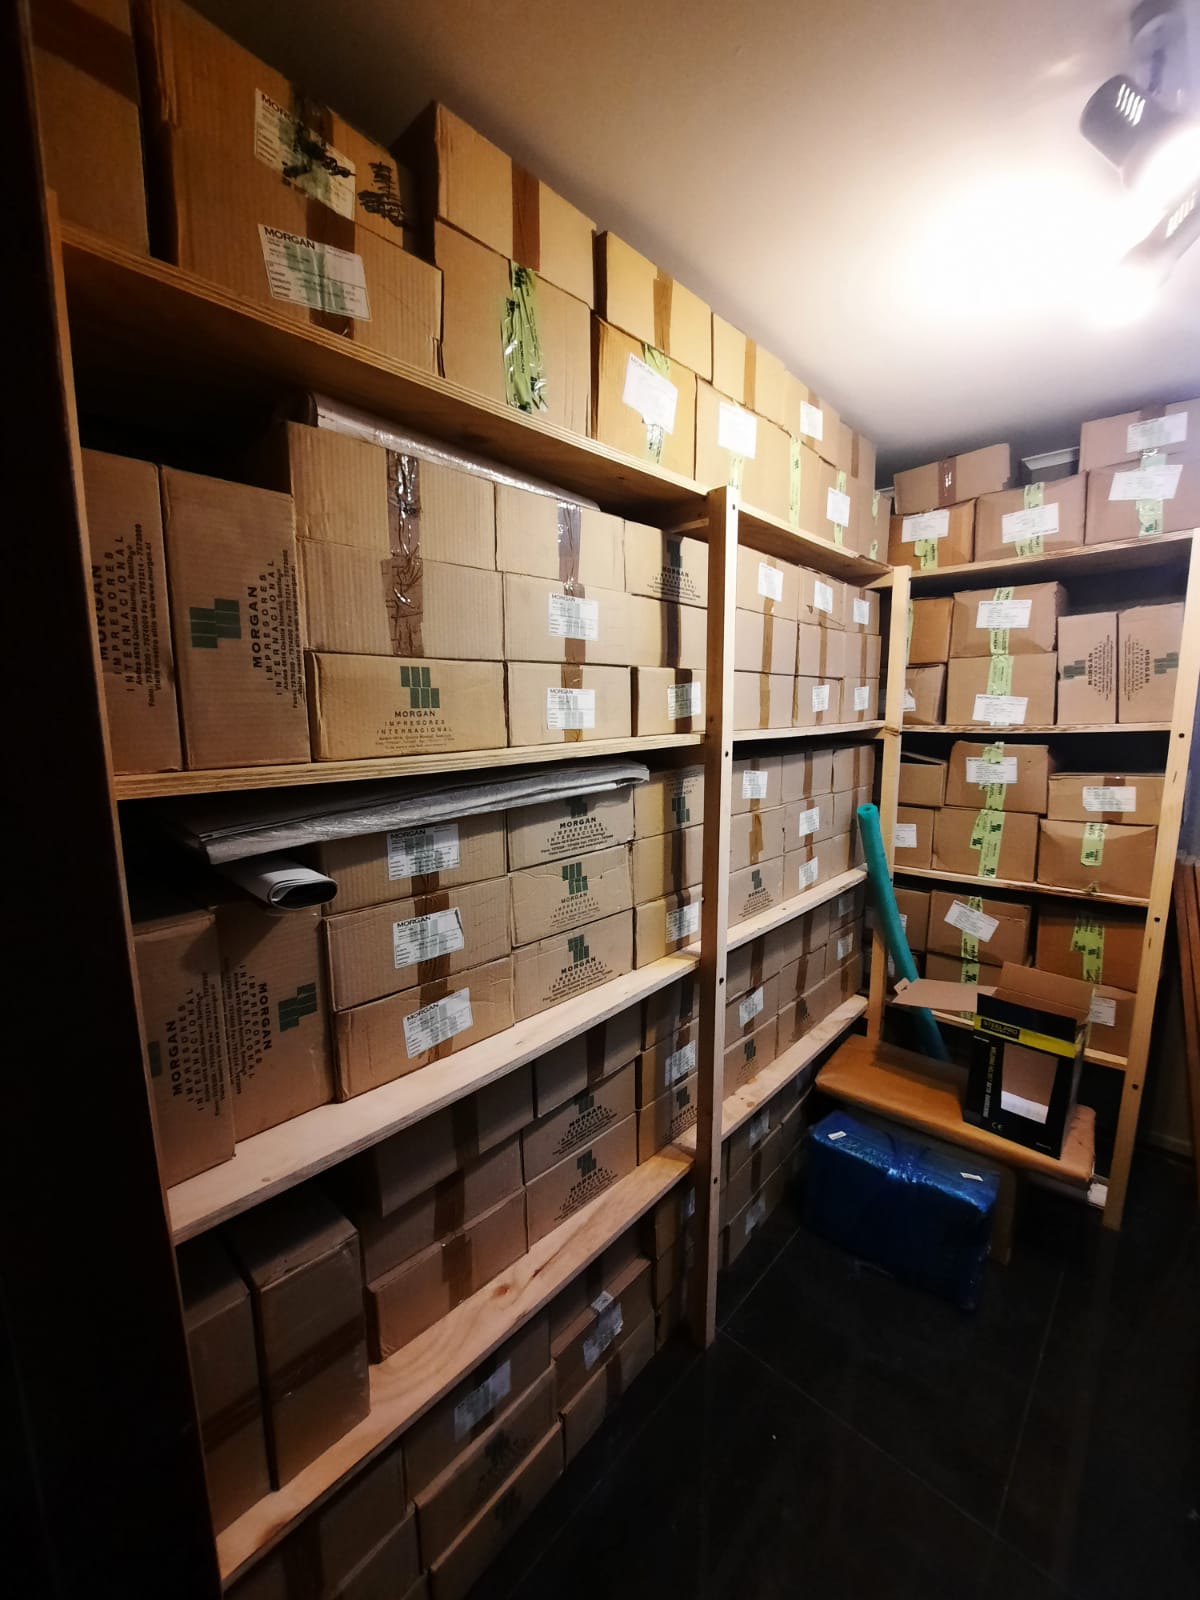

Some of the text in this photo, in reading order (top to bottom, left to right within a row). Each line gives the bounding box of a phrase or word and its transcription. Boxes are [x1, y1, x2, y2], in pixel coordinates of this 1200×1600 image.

[264, 226, 316, 250] MORGAN
[104, 552, 122, 675] IMPRESORES
[114, 536, 135, 691] INTERNACIONAL
[247, 586, 262, 669] MORGAN
[259, 574, 274, 681] IMPRESORES
[267, 561, 283, 696] INTERNACIONAL
[394, 710, 436, 718] MORGAN
[390, 829, 426, 839] MORGAN
[560, 817, 597, 830] MORGAN
[561, 892, 588, 904] MORGAN
[397, 916, 432, 929] MORGAN
[561, 956, 597, 974] MORGAN
[258, 982, 272, 1050] MORGAN
[406, 1003, 440, 1022] MORGAN
[166, 1021, 183, 1097] MORGAN
